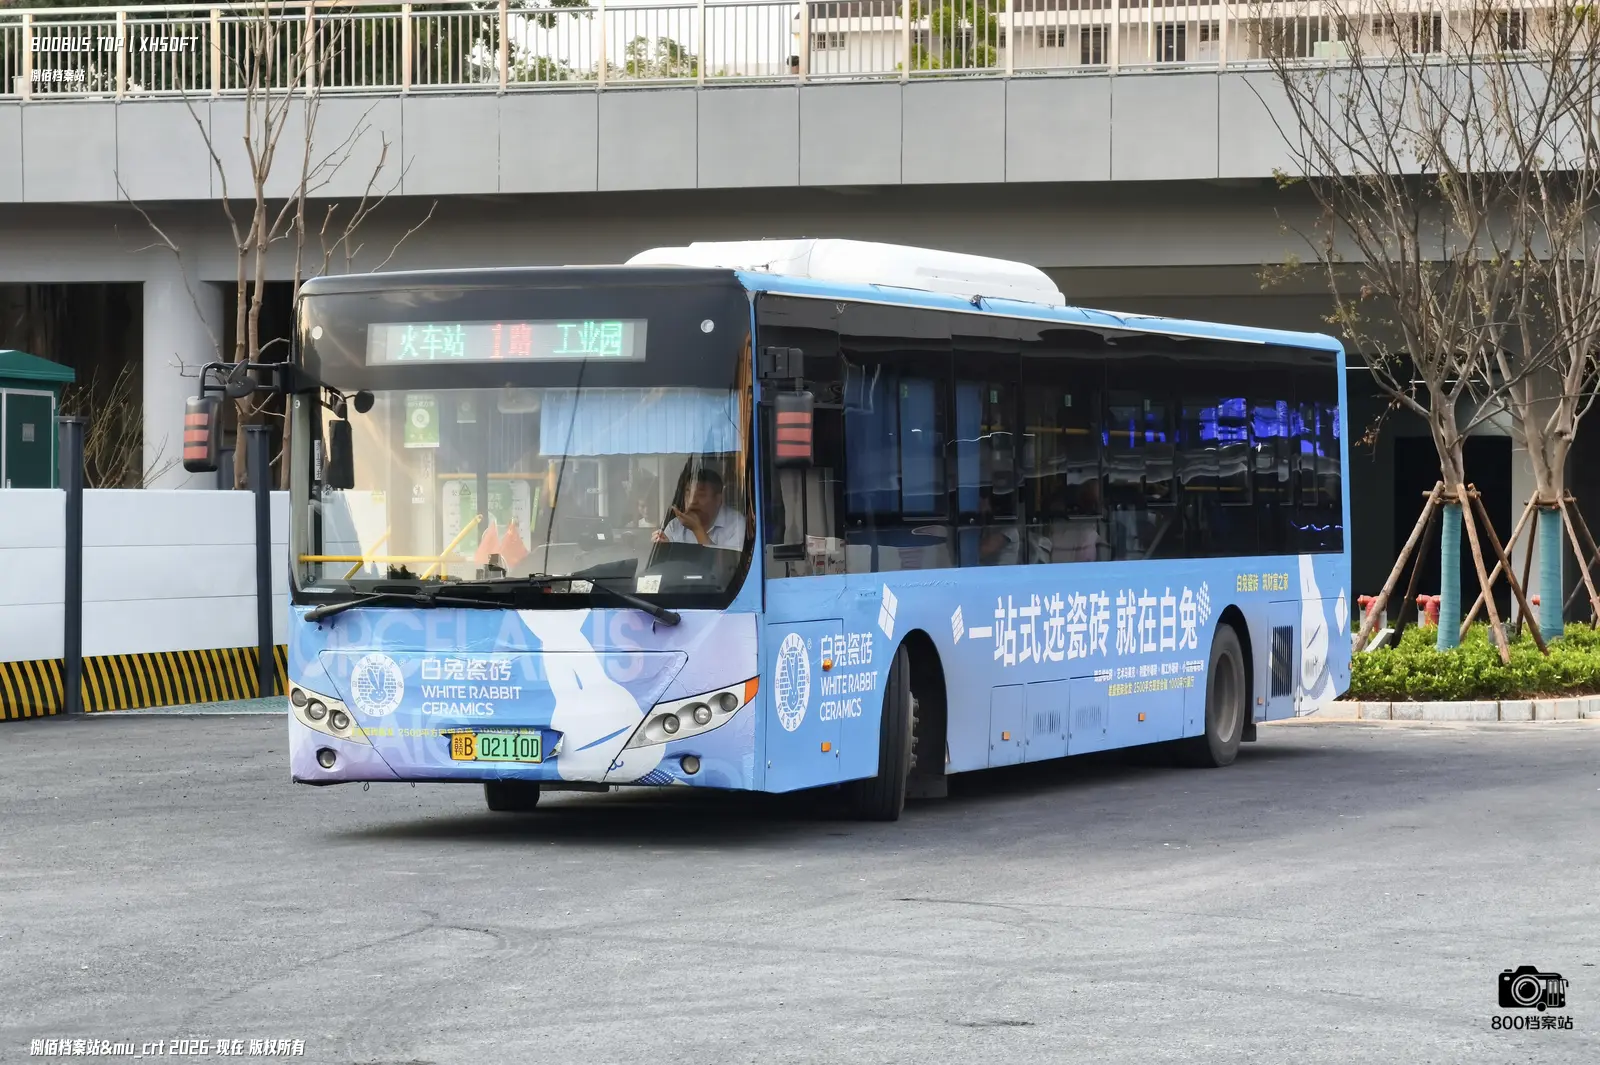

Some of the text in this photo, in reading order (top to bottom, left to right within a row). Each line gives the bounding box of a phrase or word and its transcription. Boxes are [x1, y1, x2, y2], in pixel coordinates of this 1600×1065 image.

[398, 324, 466, 360] 火车站
[553, 321, 623, 356] 工业园
[1236, 573, 1259, 592] 白兔瓷砖
[969, 586, 1198, 667] 一站式选瓷砖 就在白兔
[821, 632, 873, 668] 白兔瓷砖
[421, 659, 512, 681] 白兔瓷砖
[421, 685, 522, 701] WHITE RABBIT
[821, 671, 878, 697] WHITE RABBIT
[421, 702, 494, 717] CERAMICS
[820, 698, 862, 721] CERAMICS
[454, 737, 473, 757] 赣B
